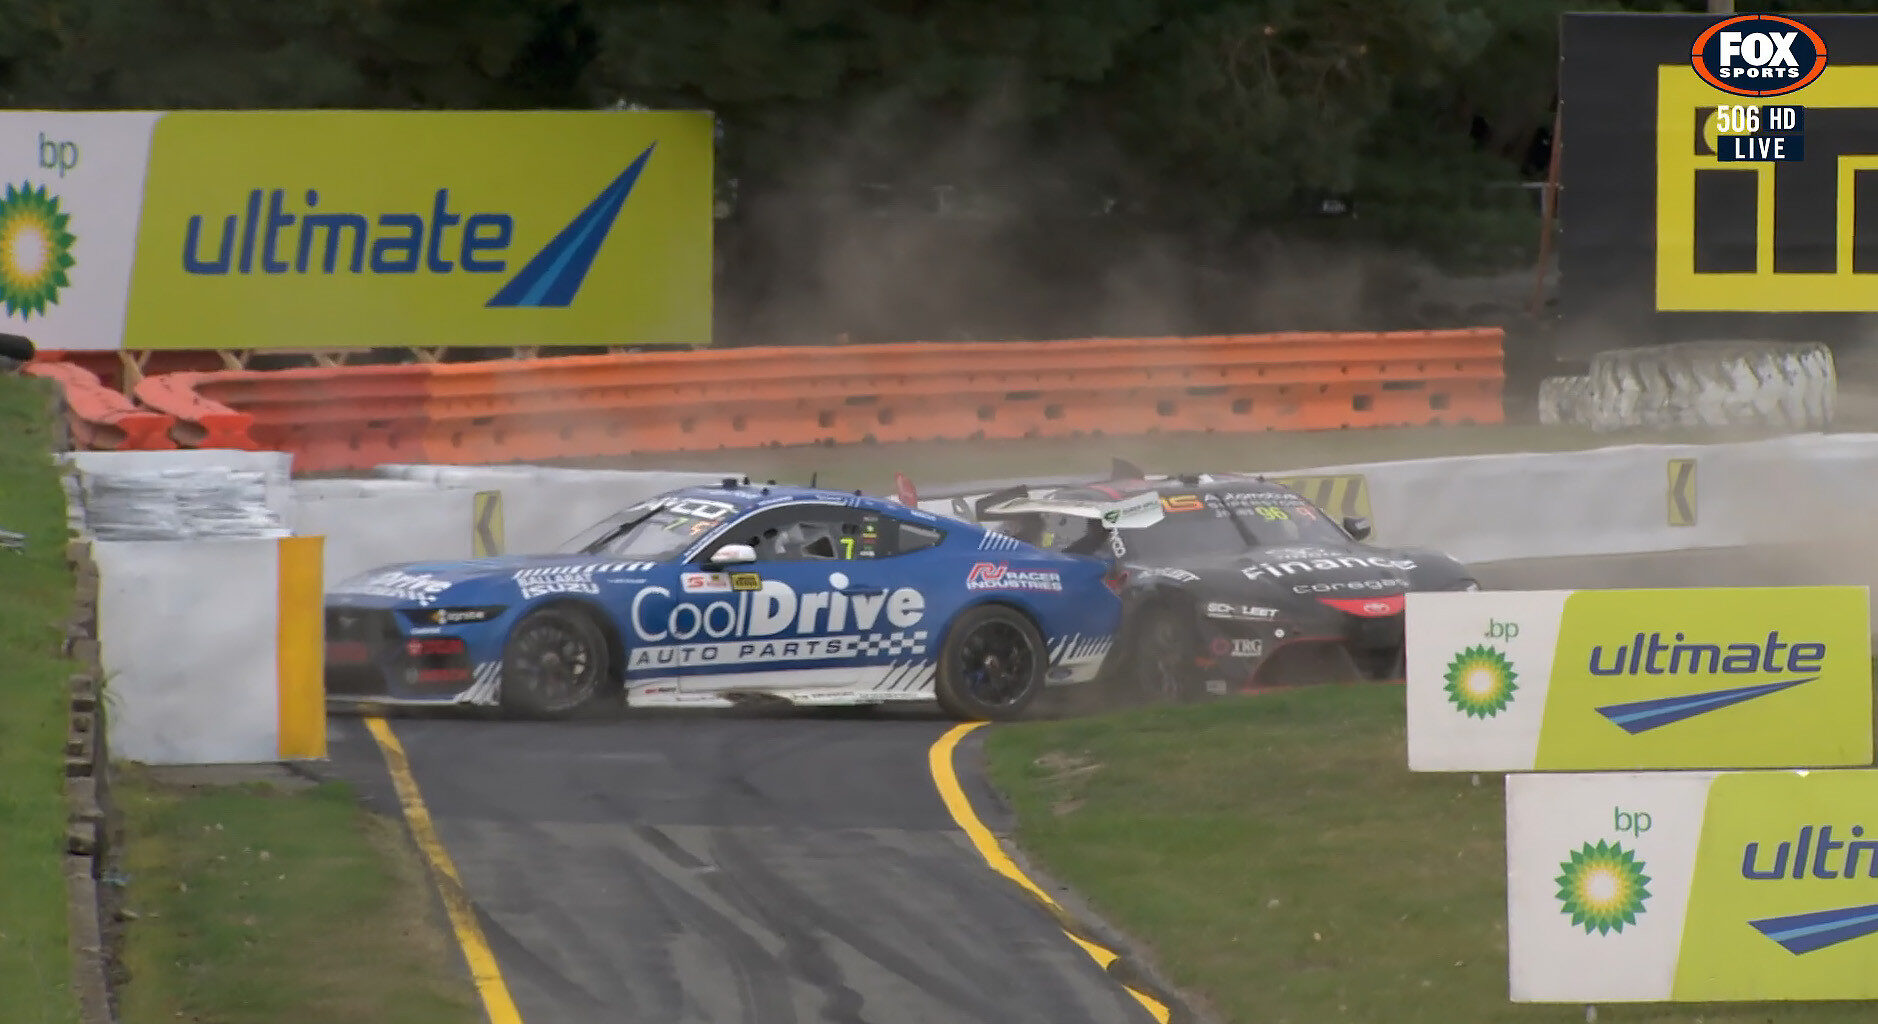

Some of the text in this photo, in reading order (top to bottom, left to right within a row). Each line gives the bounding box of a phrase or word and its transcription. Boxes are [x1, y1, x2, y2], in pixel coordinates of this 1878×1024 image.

[38, 133, 78, 176] bp
[183, 188, 514, 275] ultimate
[840, 537, 856, 560] 7
[1006, 572, 1060, 581] RACER
[1241, 554, 1418, 581] Finance
[967, 580, 1063, 591] INDUSTRIES
[631, 572, 926, 642] CoolDrive
[1489, 618, 1520, 643] bp
[636, 638, 844, 667] AUTO PARTS
[1589, 630, 1826, 676] ultimate
[1614, 806, 1652, 837] bp
